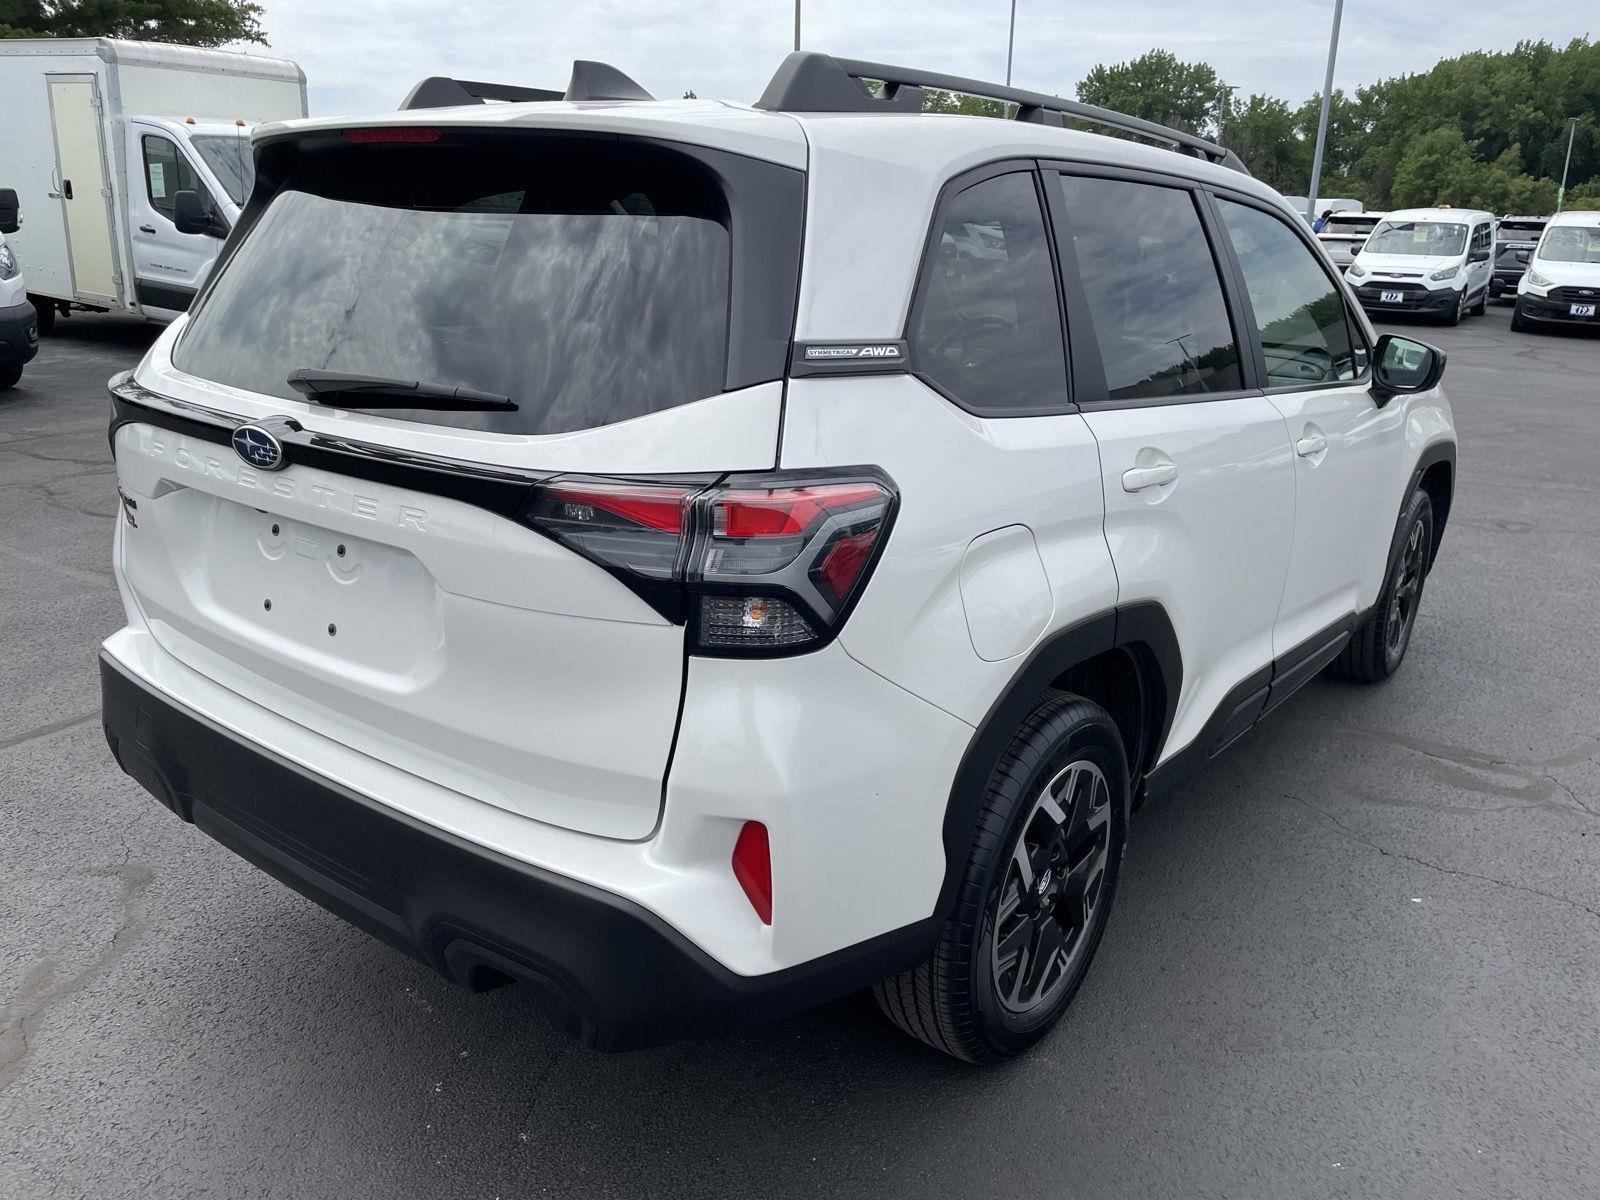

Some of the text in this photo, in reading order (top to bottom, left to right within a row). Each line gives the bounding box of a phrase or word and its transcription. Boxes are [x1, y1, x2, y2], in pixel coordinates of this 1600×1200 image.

[807, 346, 899, 356] SYMMETRICAL AWD
[149, 438, 428, 533] FORESTER
